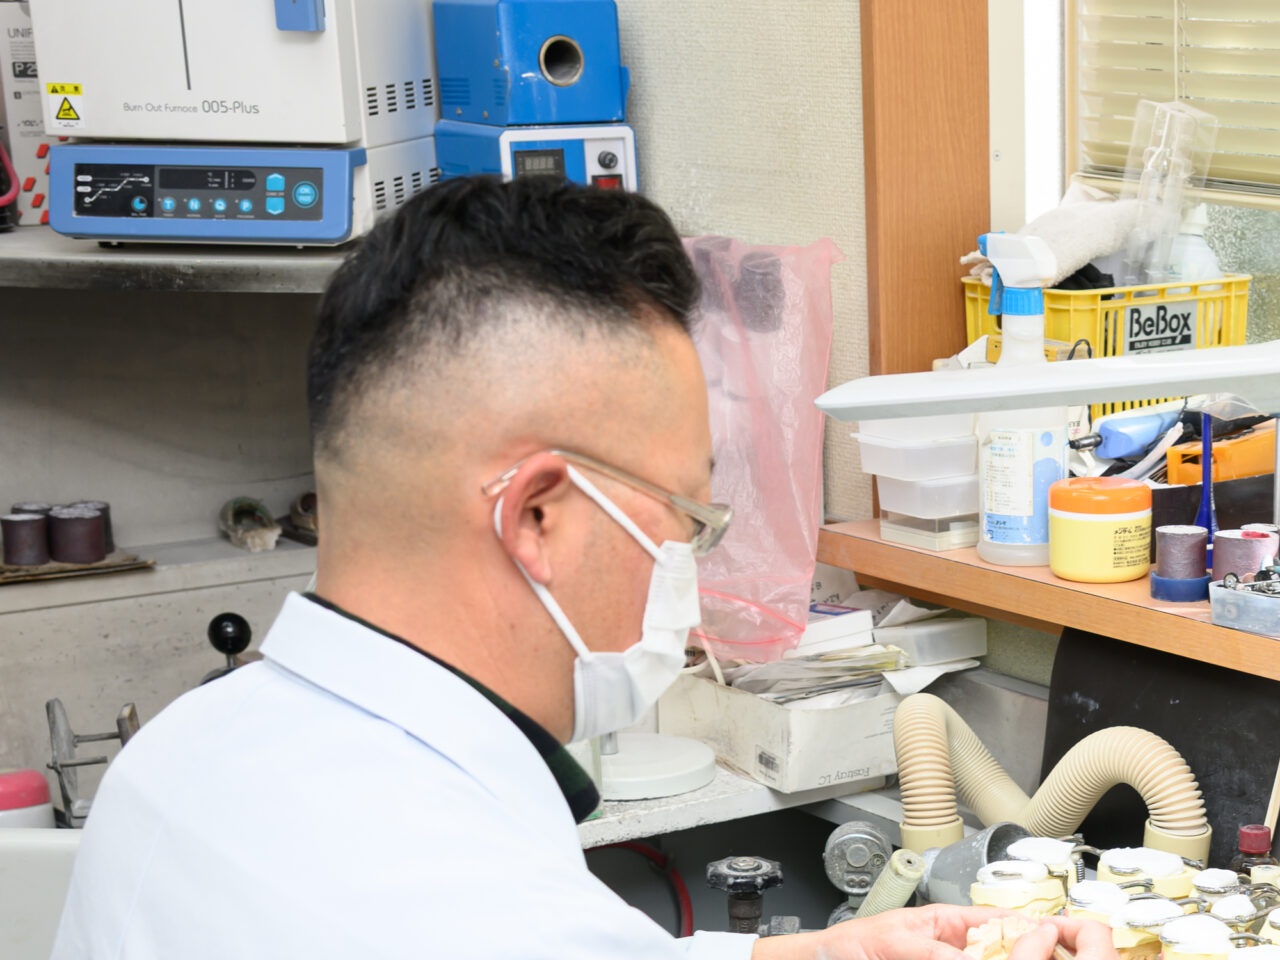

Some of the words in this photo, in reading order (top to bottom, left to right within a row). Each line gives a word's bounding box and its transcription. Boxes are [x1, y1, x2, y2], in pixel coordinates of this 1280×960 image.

[123, 102, 143, 112] Burn
[145, 102, 162, 112] Out
[164, 103, 198, 113] Furnace
[202, 100, 260, 114] 005-Plus
[1129, 305, 1191, 338] BeBox
